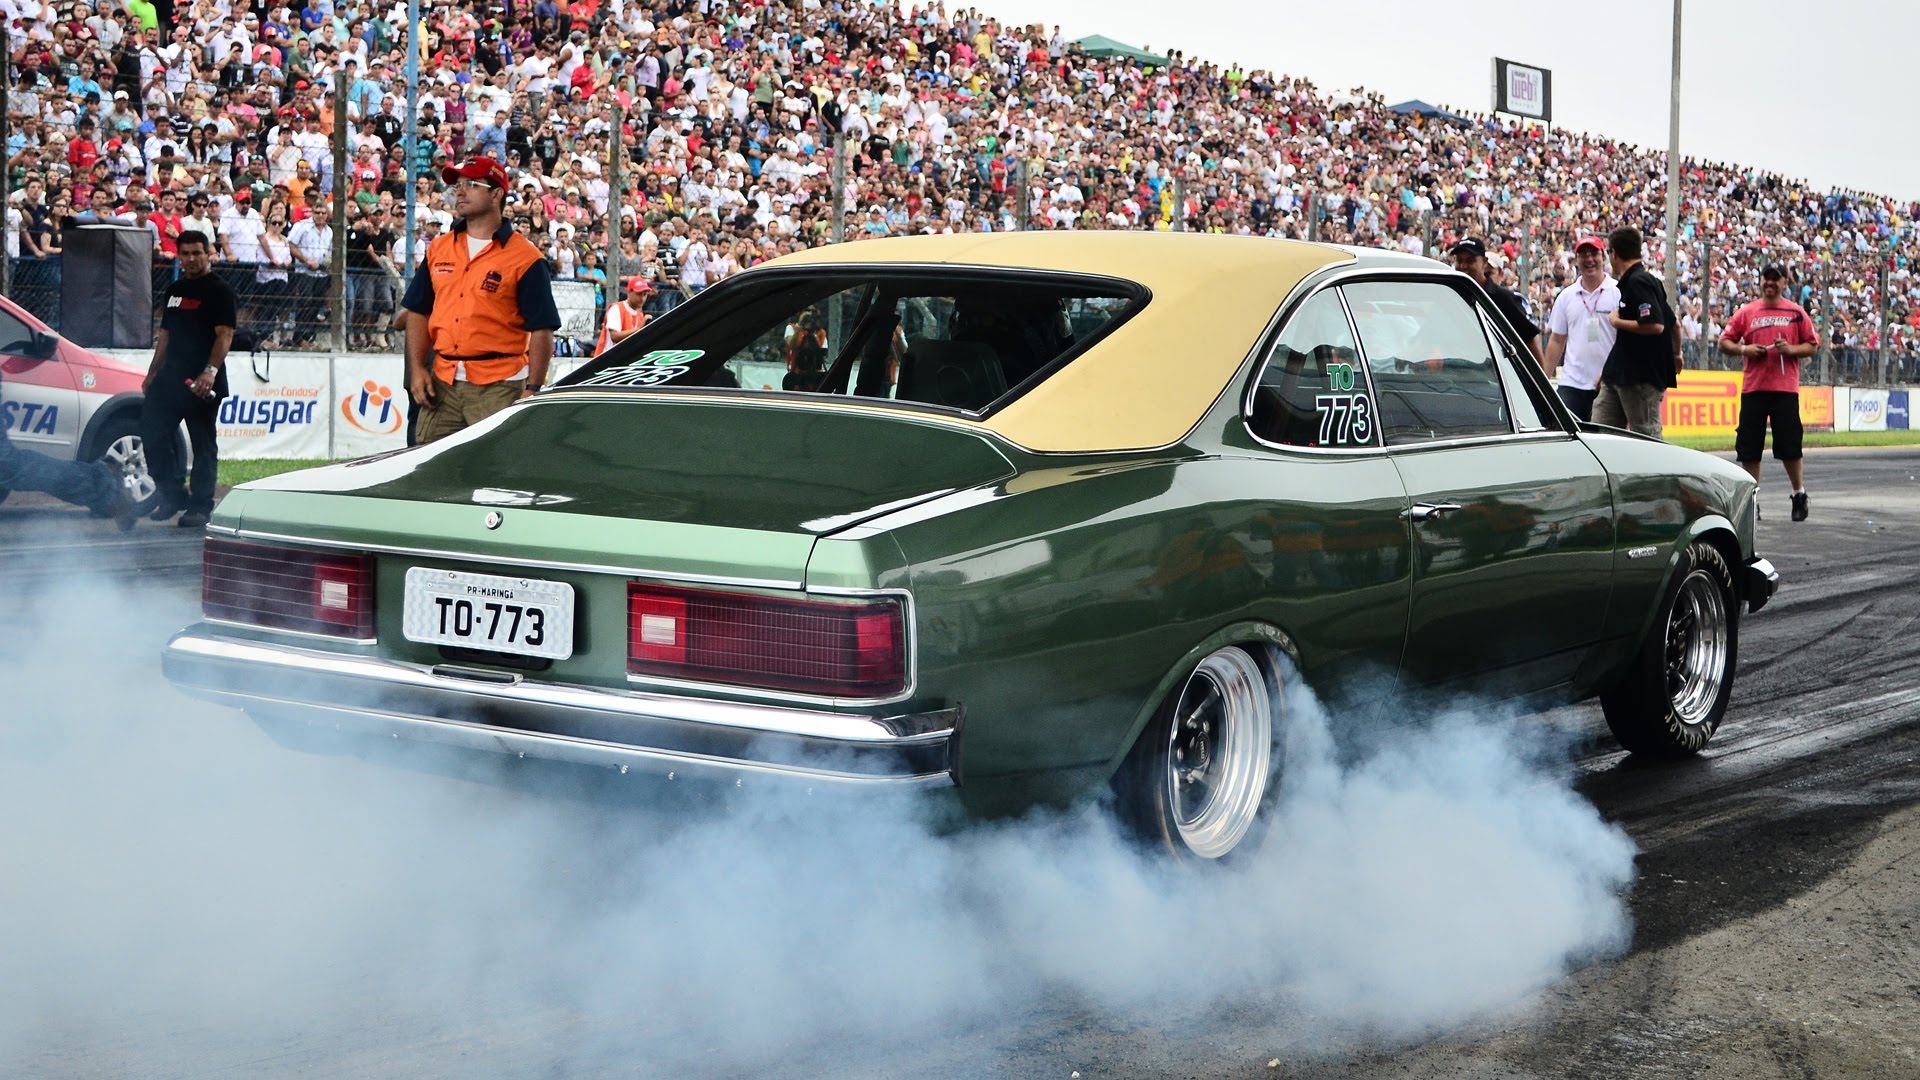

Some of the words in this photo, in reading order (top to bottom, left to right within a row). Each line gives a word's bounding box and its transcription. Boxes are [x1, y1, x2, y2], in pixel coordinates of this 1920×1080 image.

[628, 349, 706, 366] TO
[1326, 362, 1355, 391] TO
[254, 388, 280, 397] GRUPO
[281, 385, 319, 397] Condusa
[1315, 393, 1372, 445] 773
